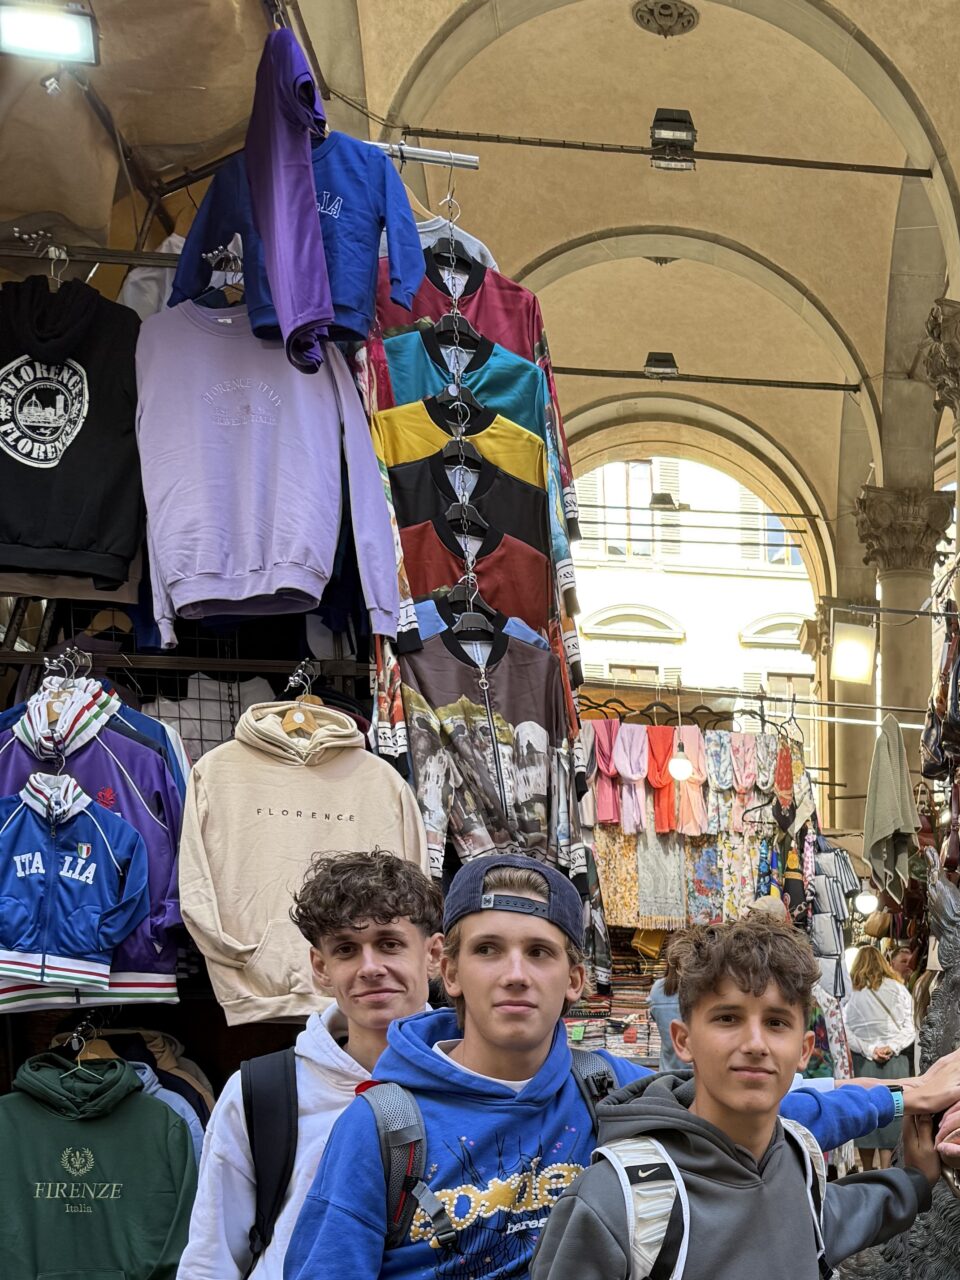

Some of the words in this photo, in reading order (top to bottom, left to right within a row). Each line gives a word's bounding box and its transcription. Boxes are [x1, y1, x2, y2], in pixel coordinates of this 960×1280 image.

[316, 191, 343, 218] IA
[256, 808, 355, 822] FLORENCE
[33, 1182, 123, 1199] FIRENZE
[65, 1203, 93, 1213] Italia
